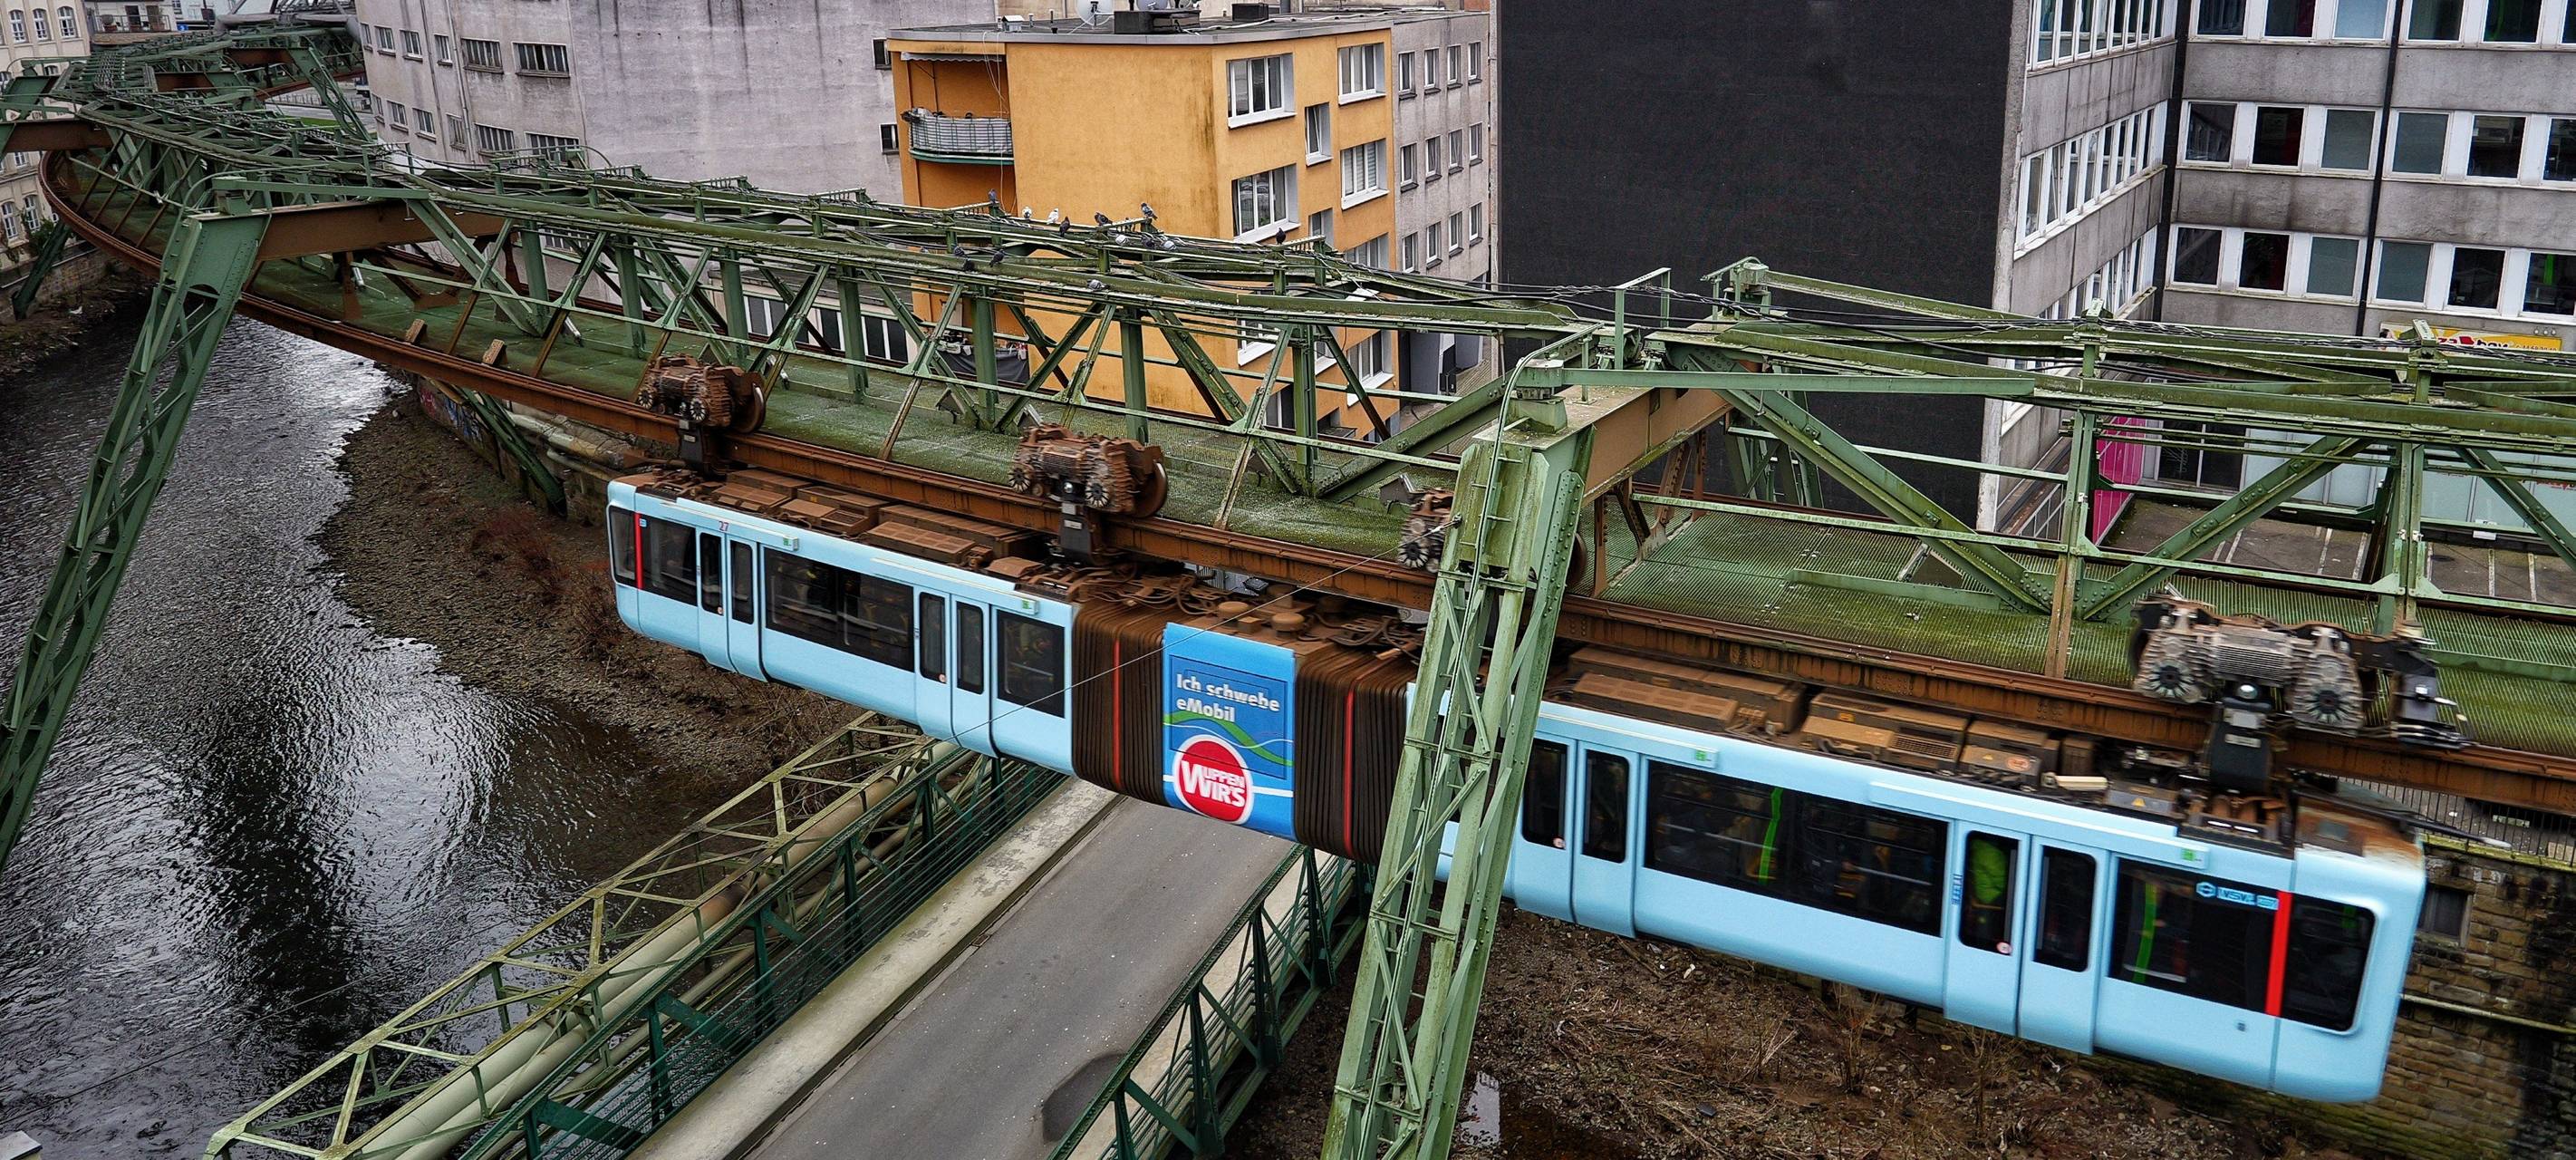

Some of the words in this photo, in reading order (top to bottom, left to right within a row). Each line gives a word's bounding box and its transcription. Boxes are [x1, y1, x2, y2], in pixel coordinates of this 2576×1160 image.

[1176, 673, 1202, 693] Ich
[1206, 683, 1280, 712] schwebe
[1176, 697, 1236, 723] eMobil
